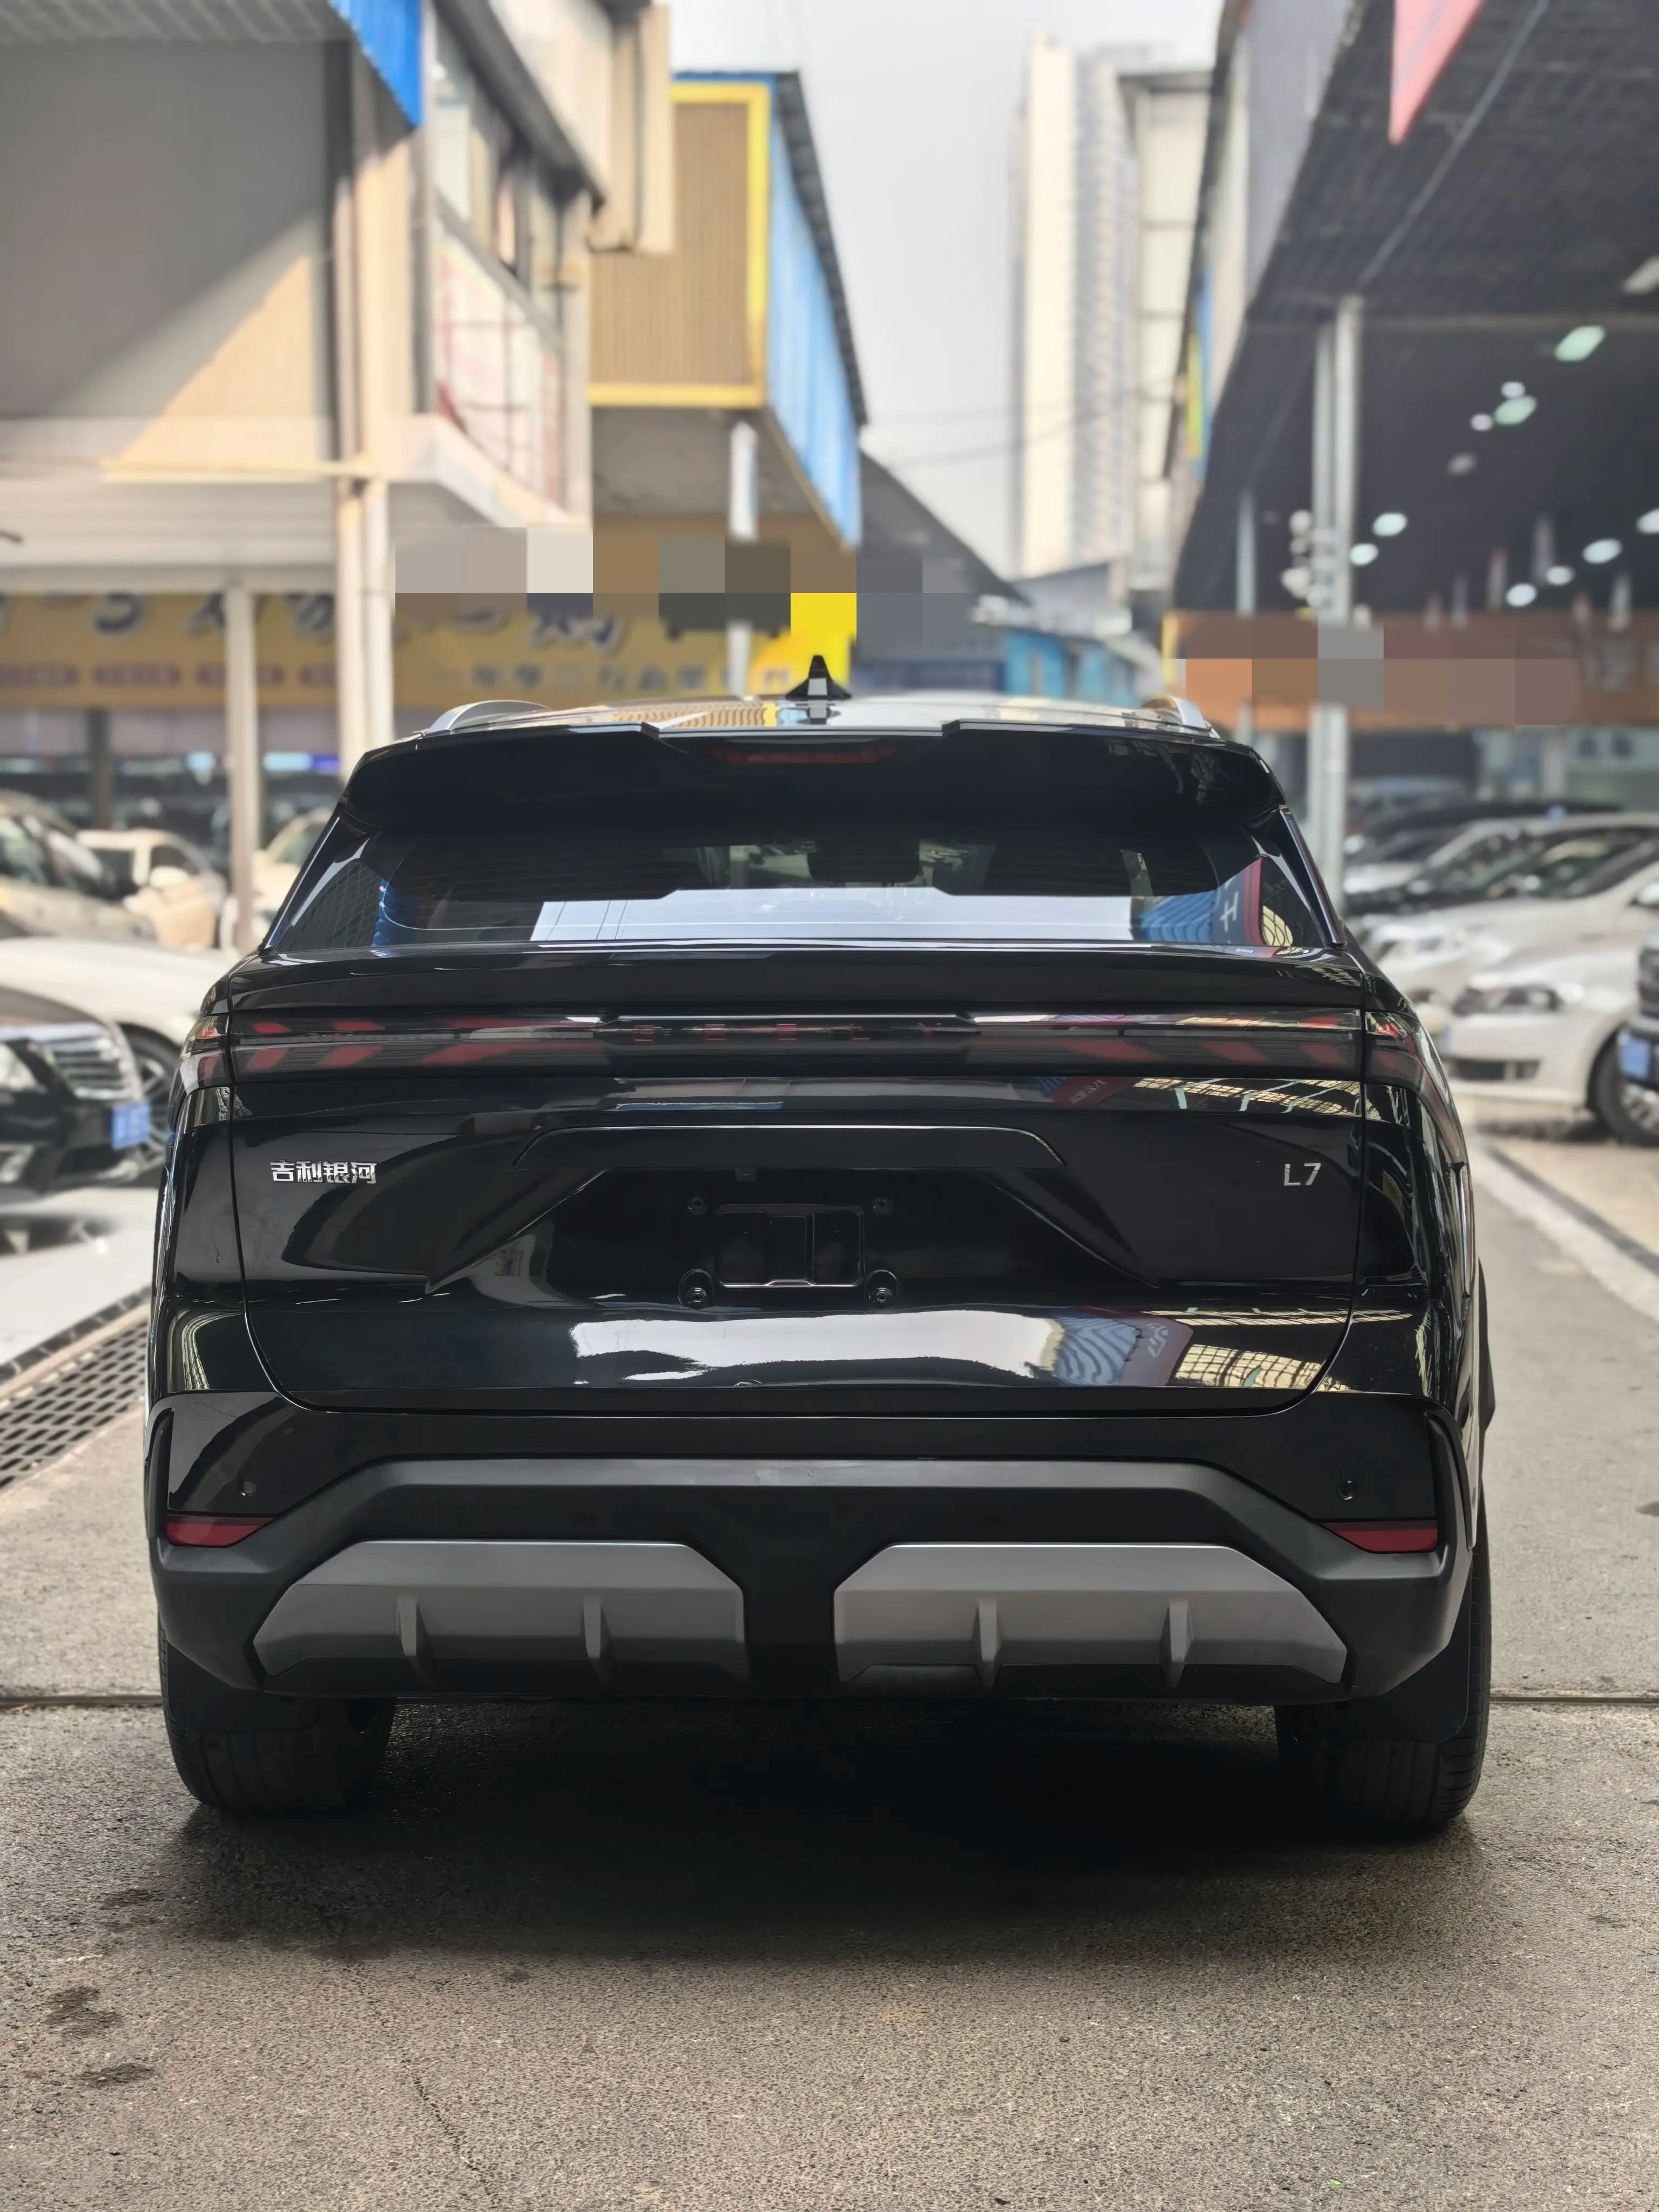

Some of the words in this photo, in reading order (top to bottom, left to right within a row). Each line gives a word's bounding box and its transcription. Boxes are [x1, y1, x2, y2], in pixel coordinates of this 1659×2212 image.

[270, 1159, 377, 1184] 吉利银河
[1284, 1163, 1321, 1186] L7
